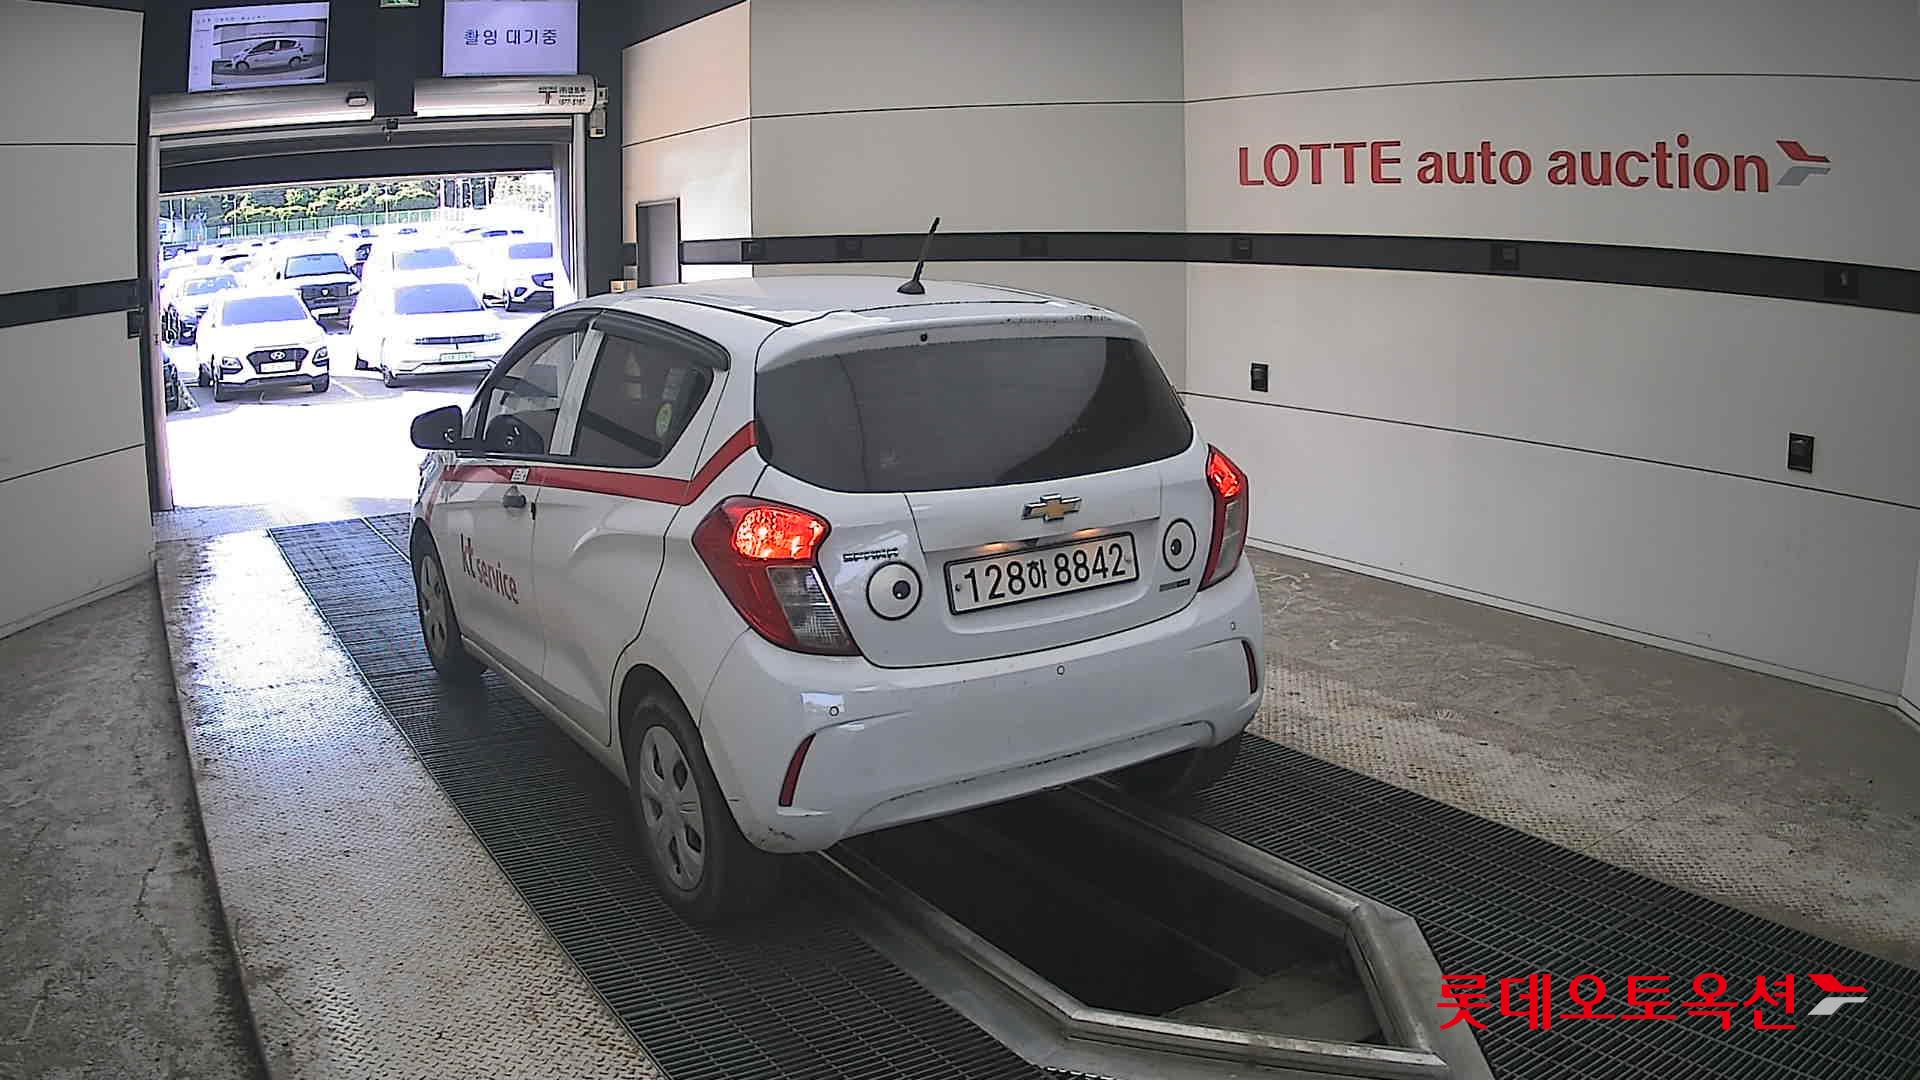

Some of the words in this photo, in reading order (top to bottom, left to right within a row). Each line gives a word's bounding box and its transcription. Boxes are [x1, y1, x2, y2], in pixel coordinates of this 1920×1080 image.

[464, 29, 497, 46] 촬영
[506, 29, 557, 46] 대기중
[1238, 140, 1401, 188] LOTTE
[1416, 141, 1533, 185] auto
[1547, 133, 1770, 192] auction
[477, 558, 519, 605] service
[964, 559, 1048, 603] 128하
[1054, 543, 1126, 587] 8842
